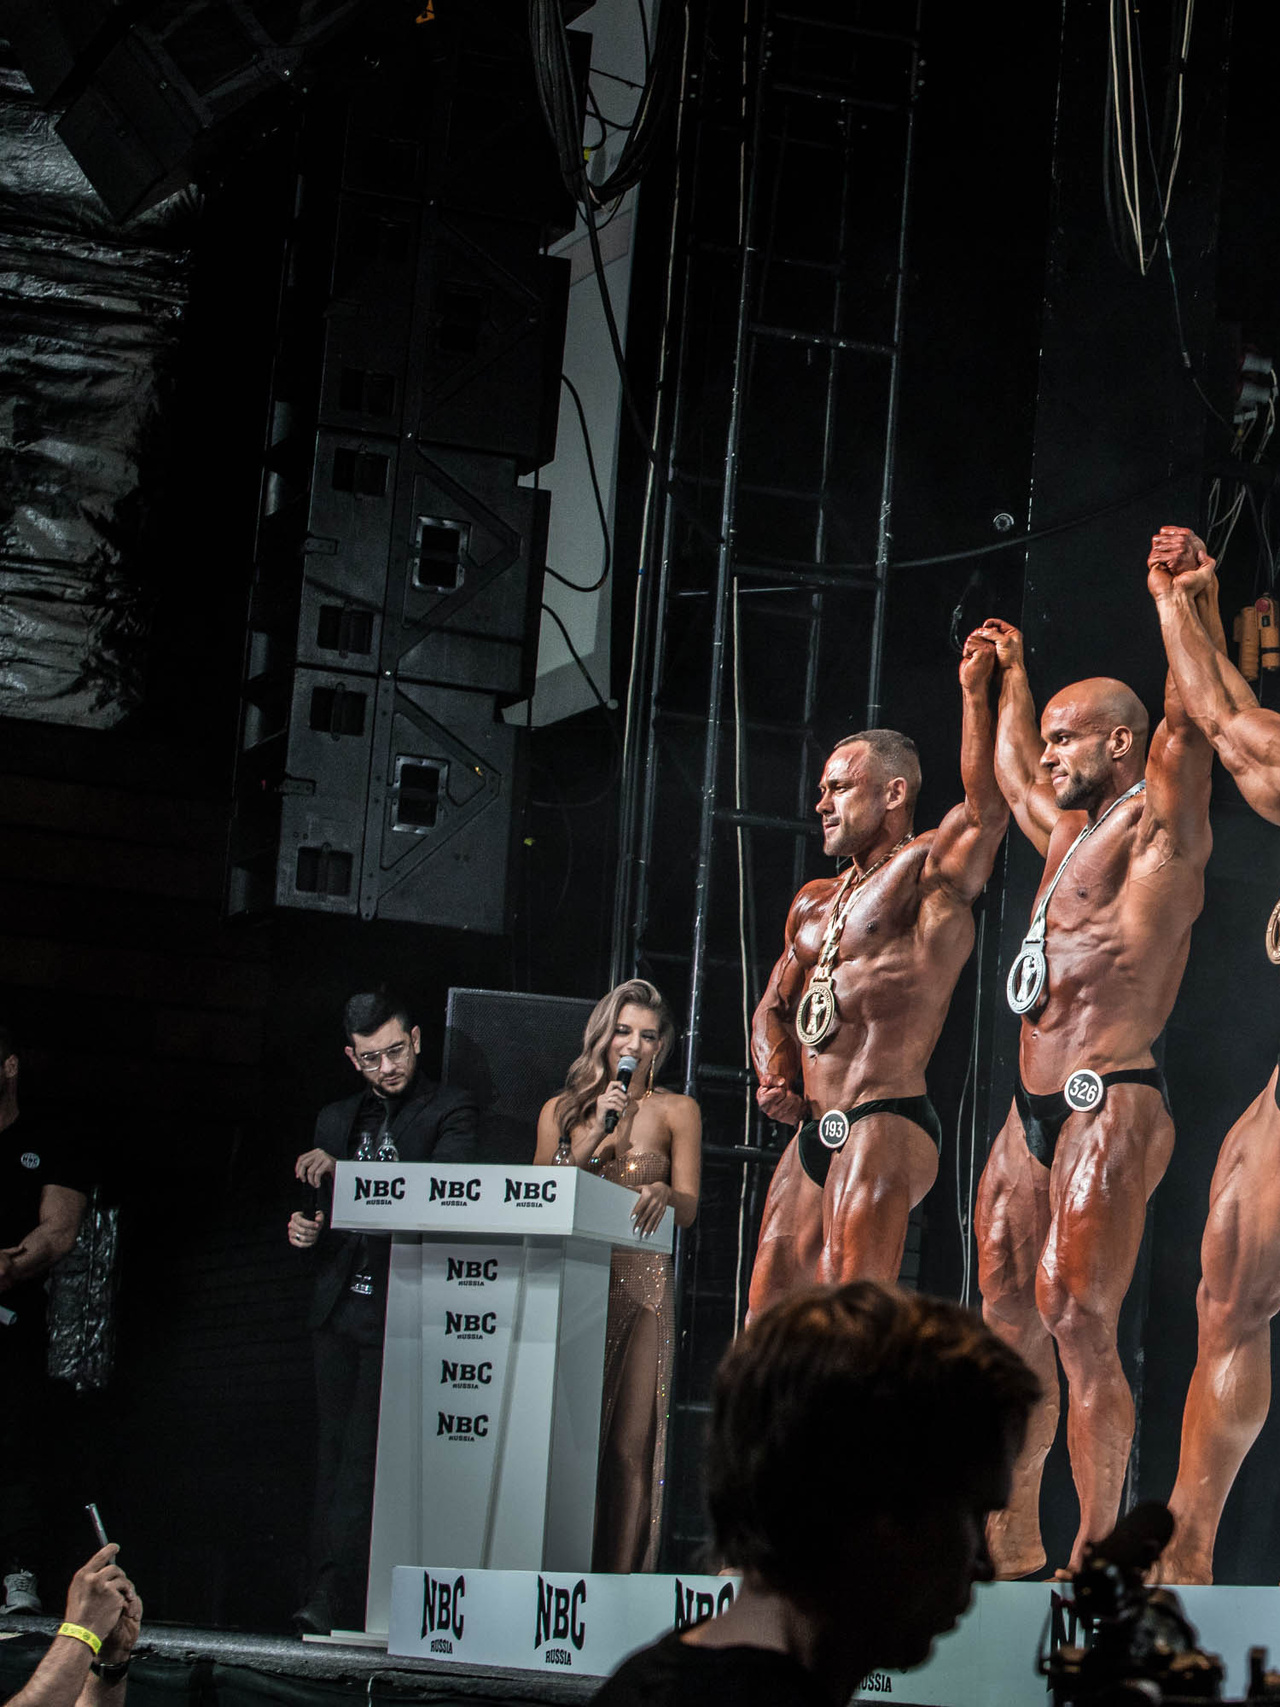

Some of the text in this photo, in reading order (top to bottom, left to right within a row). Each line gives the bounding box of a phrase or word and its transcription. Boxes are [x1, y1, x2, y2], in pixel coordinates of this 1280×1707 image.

[1069, 1078, 1098, 1103] 326
[824, 1120, 844, 1138] 193
[354, 1177, 557, 1202] NBC NBC NBC
[446, 1257, 498, 1282] NBC
[444, 1311, 497, 1335] NBC
[440, 1360, 492, 1384] NBC
[436, 1412, 489, 1437] NBC
[421, 1571, 465, 1640] NBC
[535, 1574, 586, 1651] NBC
[430, 1639, 453, 1655] RUSSIA
[545, 1649, 572, 1666] RUSSIA
[856, 1672, 892, 1693] USSIA
